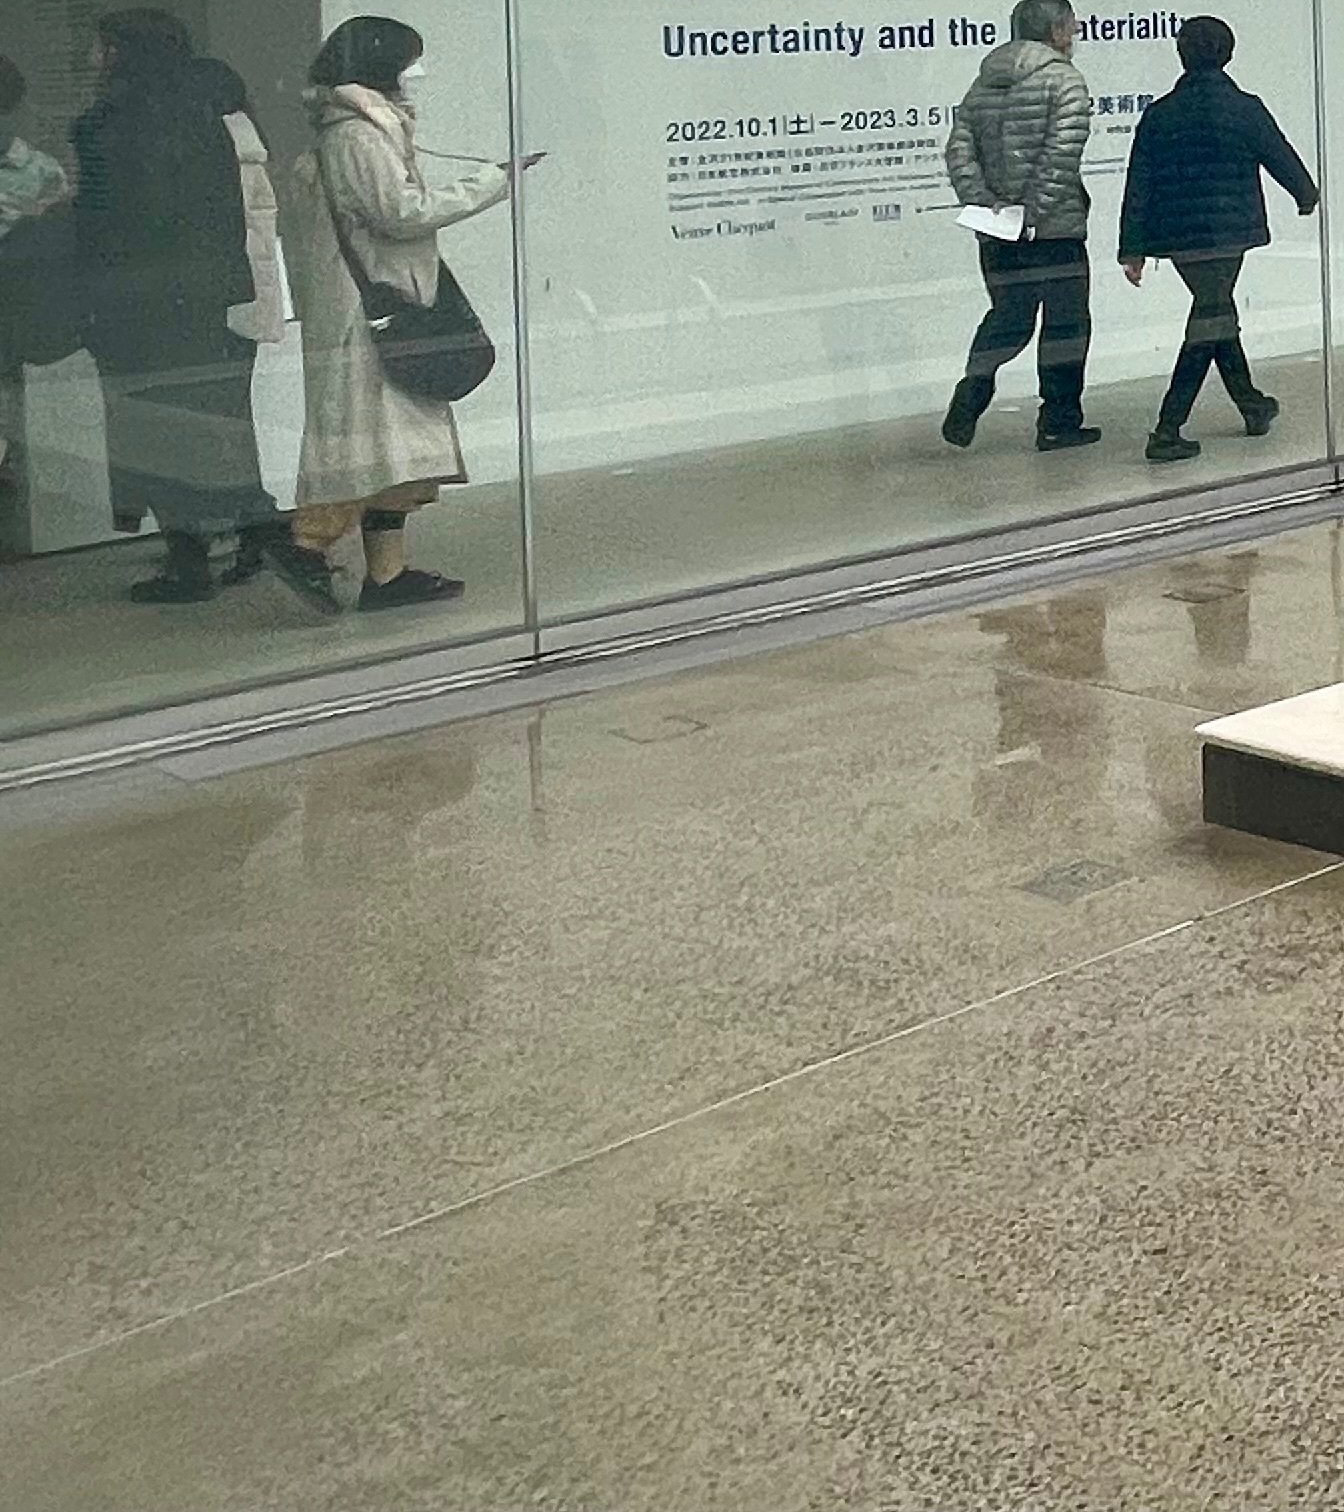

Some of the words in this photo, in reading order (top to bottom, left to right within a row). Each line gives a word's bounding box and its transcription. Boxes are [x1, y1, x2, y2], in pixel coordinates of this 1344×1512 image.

[663, 21, 864, 57] Uncertainty
[878, 18, 935, 49] and
[948, 17, 996, 46] the
[1010, 10, 1186, 41] aterialit
